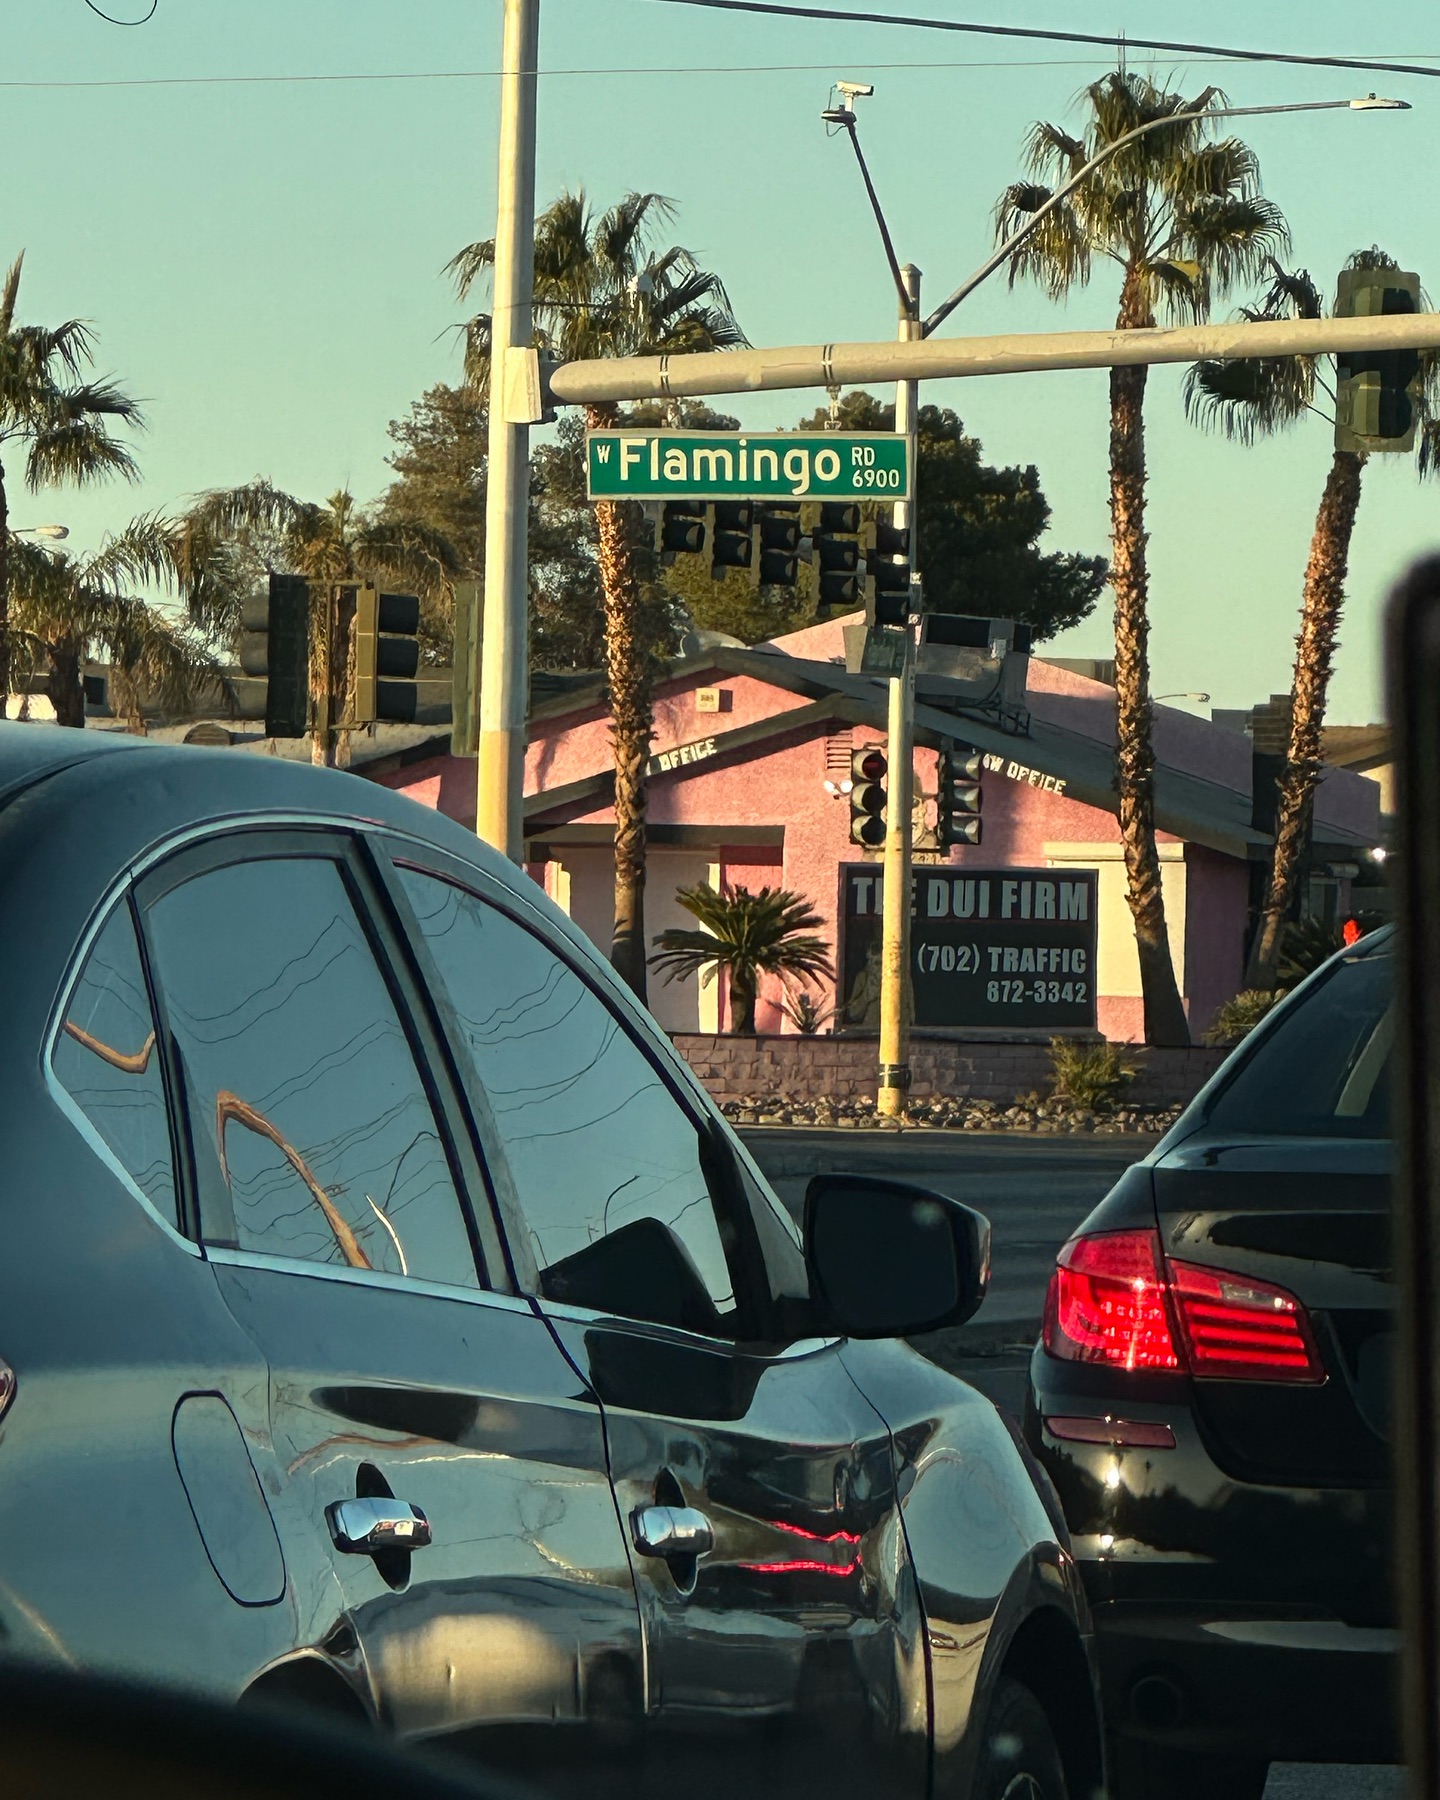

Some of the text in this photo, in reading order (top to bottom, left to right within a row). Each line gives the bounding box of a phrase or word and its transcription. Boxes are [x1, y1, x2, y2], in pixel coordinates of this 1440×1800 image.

[596, 437, 876, 496] W Flamingo RD
[851, 468, 900, 489] 6900
[658, 738, 718, 771] OFFICE
[1006, 761, 1067, 796] OFFICE
[926, 878, 991, 919] DUI
[1001, 880, 1089, 921] FIRM
[917, 942, 1087, 975] (702) TRAFFIC
